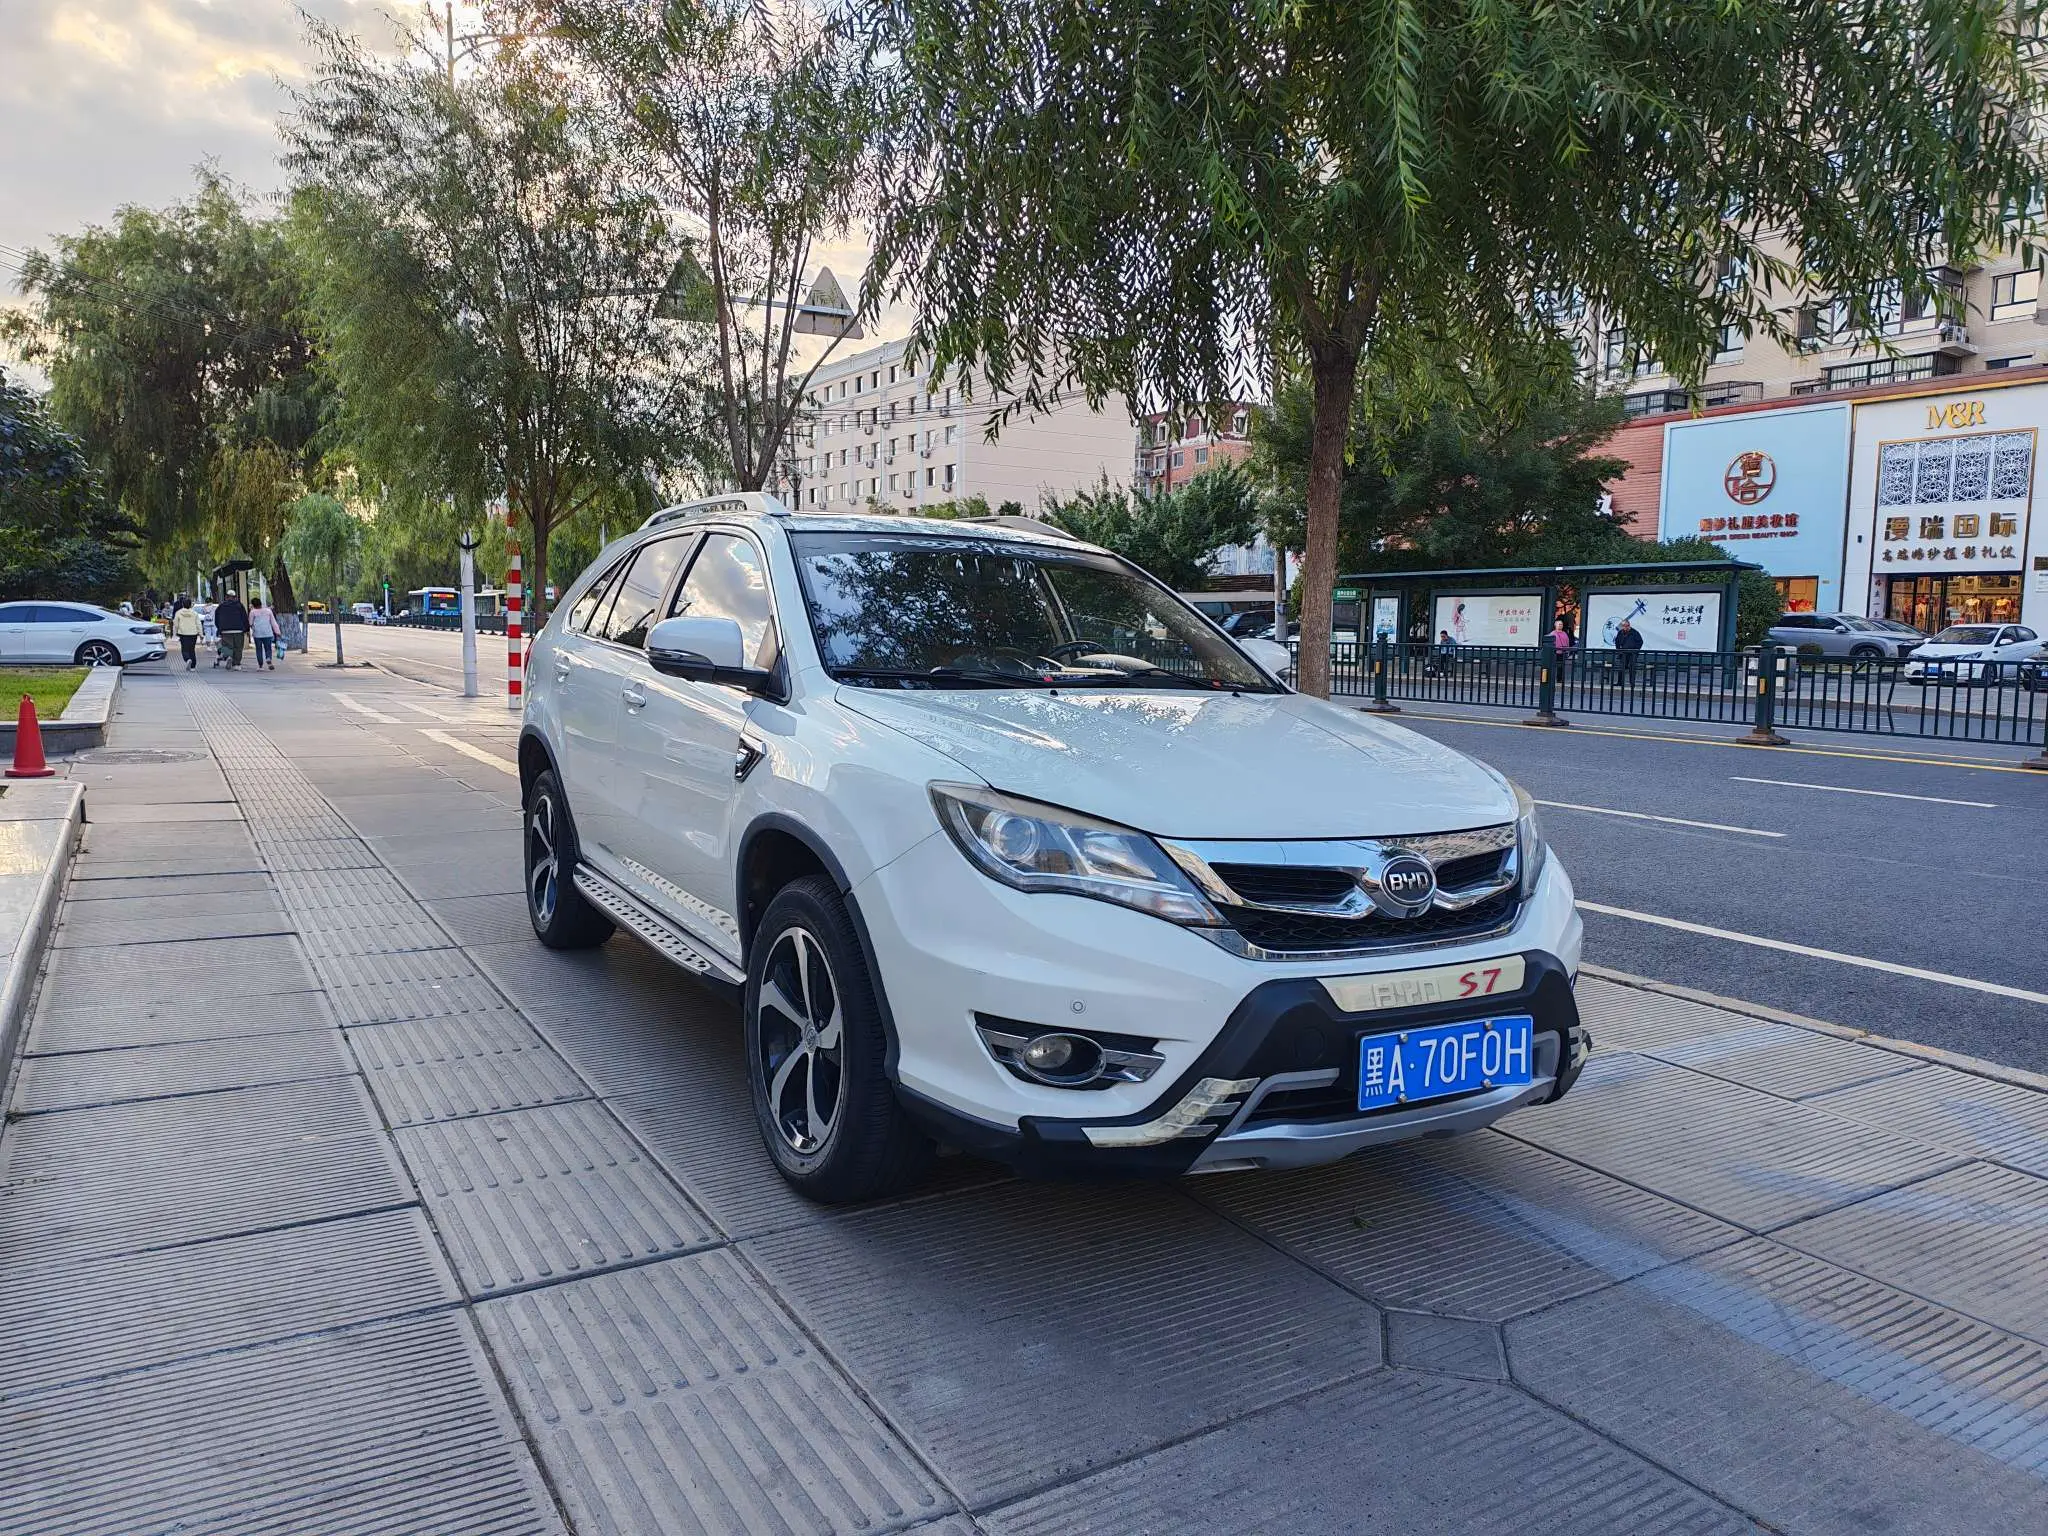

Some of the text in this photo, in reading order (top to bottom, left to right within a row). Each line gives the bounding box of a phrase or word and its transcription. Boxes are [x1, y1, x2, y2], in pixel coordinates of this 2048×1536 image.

[1924, 400, 1986, 429] M&R
[1884, 512, 2017, 541] 漫瑞国际
[1389, 871, 1429, 891] BYD
[1459, 968, 1502, 997] S7
[1365, 1027, 1527, 1097] 黑A·70F0H
